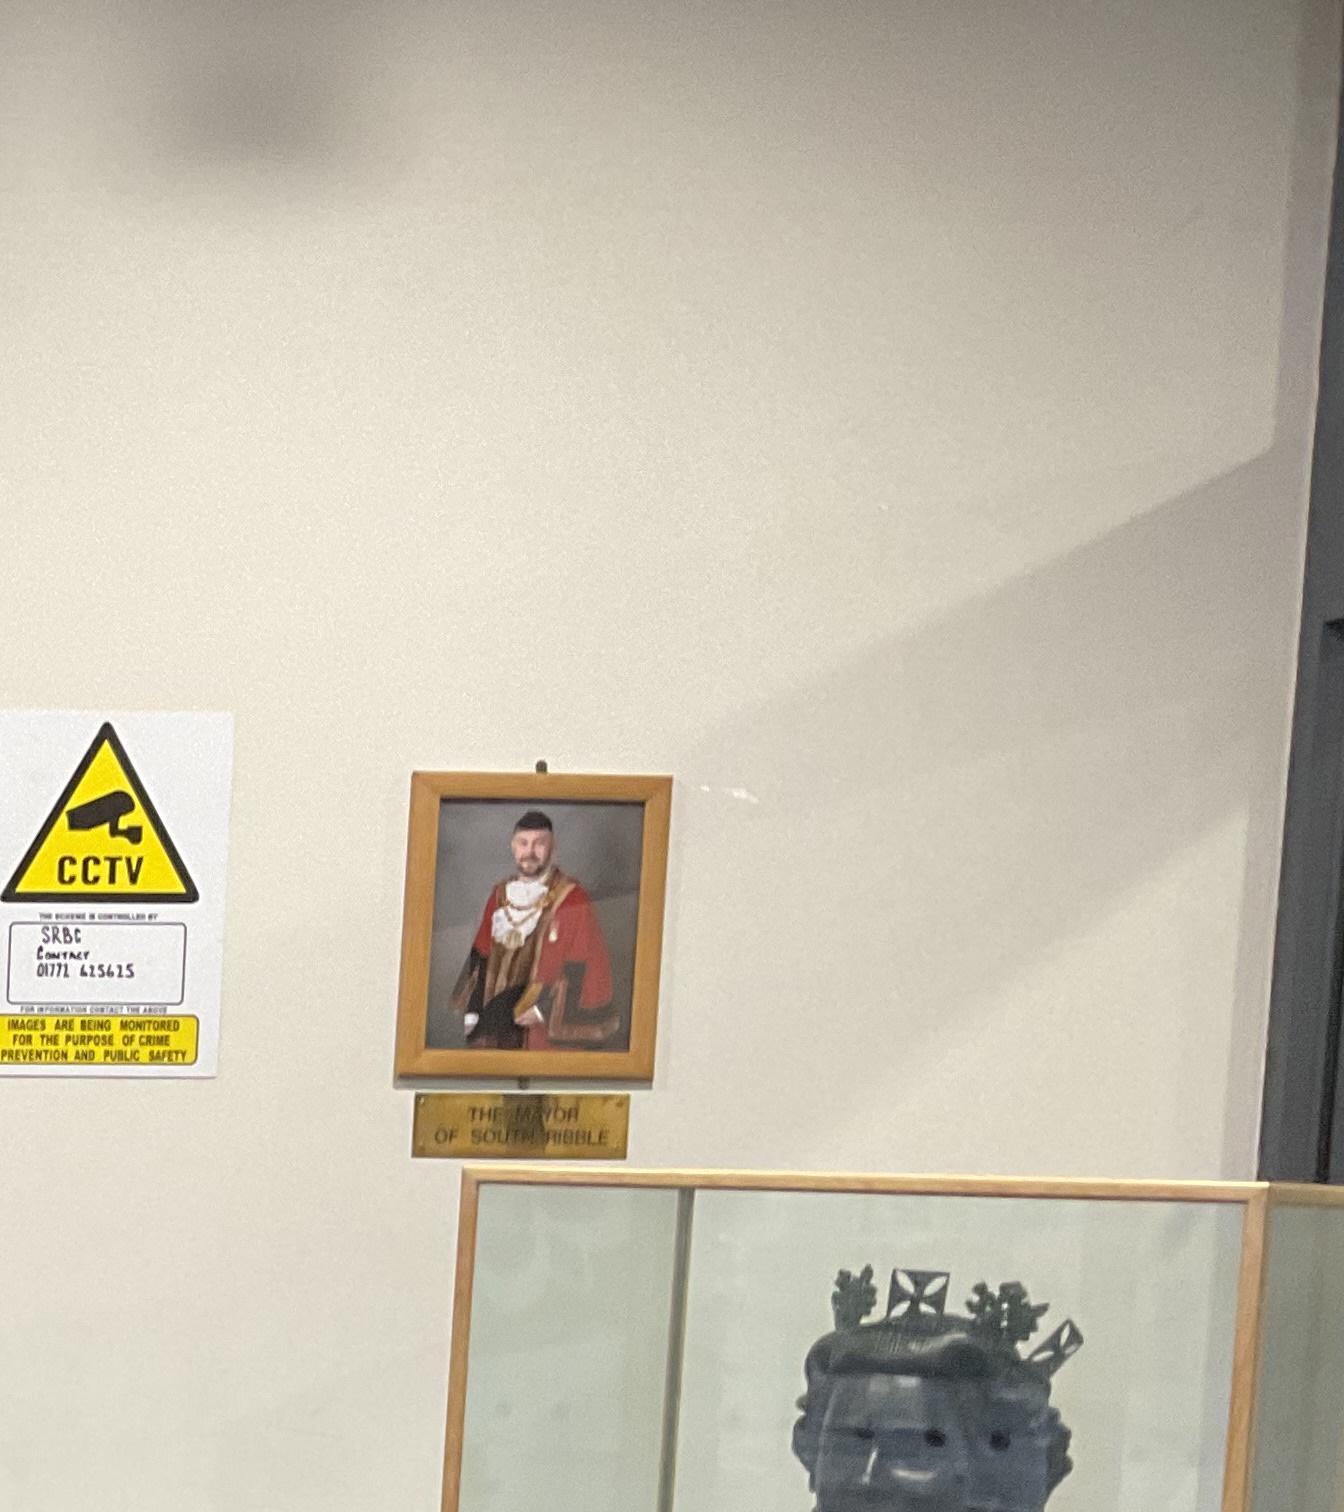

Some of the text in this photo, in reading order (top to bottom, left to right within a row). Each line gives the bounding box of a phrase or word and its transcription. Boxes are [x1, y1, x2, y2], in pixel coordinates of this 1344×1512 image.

[57, 855, 144, 886] CCTV
[41, 926, 82, 944] SRBC
[7, 1019, 180, 1032] IMAGES ARE BEING MONITORED
[13, 1033, 170, 1047] FOR THE PURPOSE OF CRIME
[0, 1048, 187, 1062] PREVENTION AND PUBLIC SAFETY
[469, 1106, 502, 1122] THE
[434, 1129, 610, 1146] OF SOUTH RIBBLE
